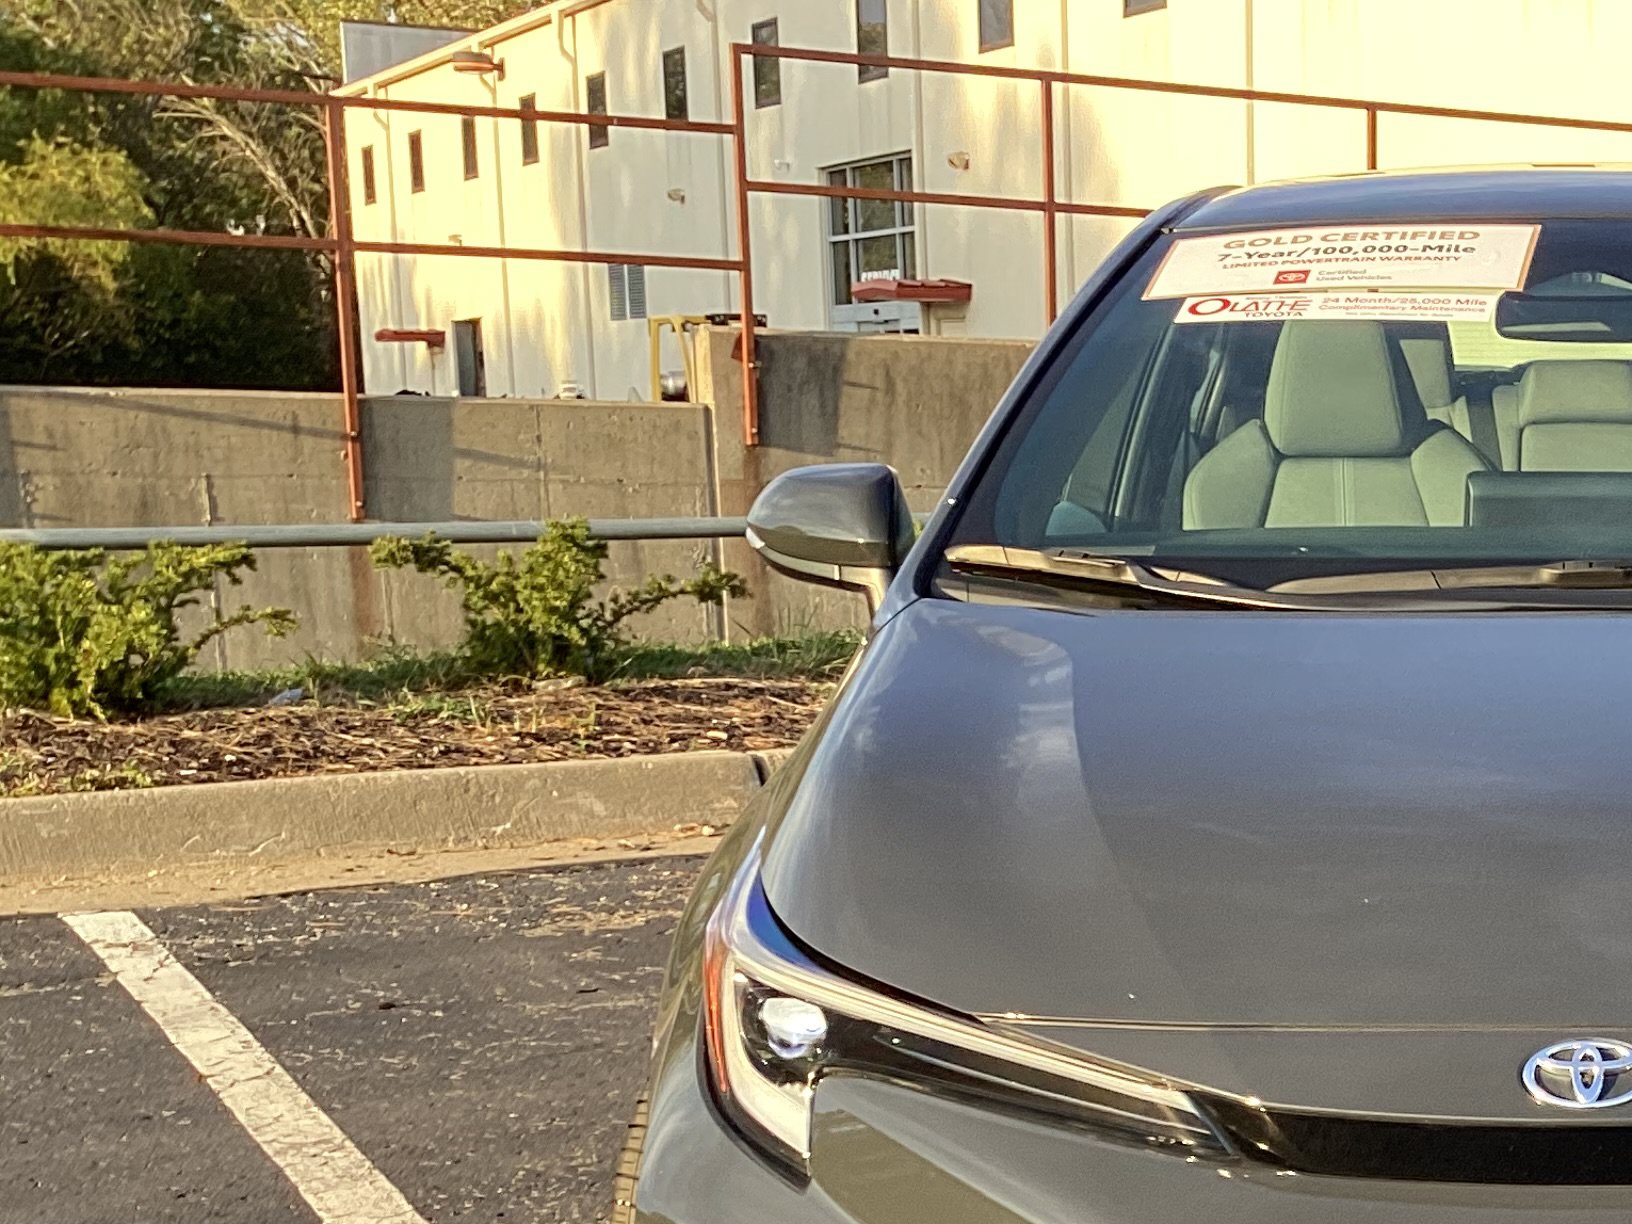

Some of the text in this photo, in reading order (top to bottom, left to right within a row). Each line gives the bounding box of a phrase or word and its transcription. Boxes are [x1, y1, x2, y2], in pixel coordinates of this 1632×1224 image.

[1223, 231, 1481, 249] GOLD CERTIFIED
[1217, 243, 1476, 262] 7-Year/100,000-Mile
[1222, 260, 1279, 270] LIMITED
[1281, 256, 1376, 265] POWERTRAIN
[1188, 298, 1313, 315] OLATHE
[1410, 305, 1486, 313] Maintenance
